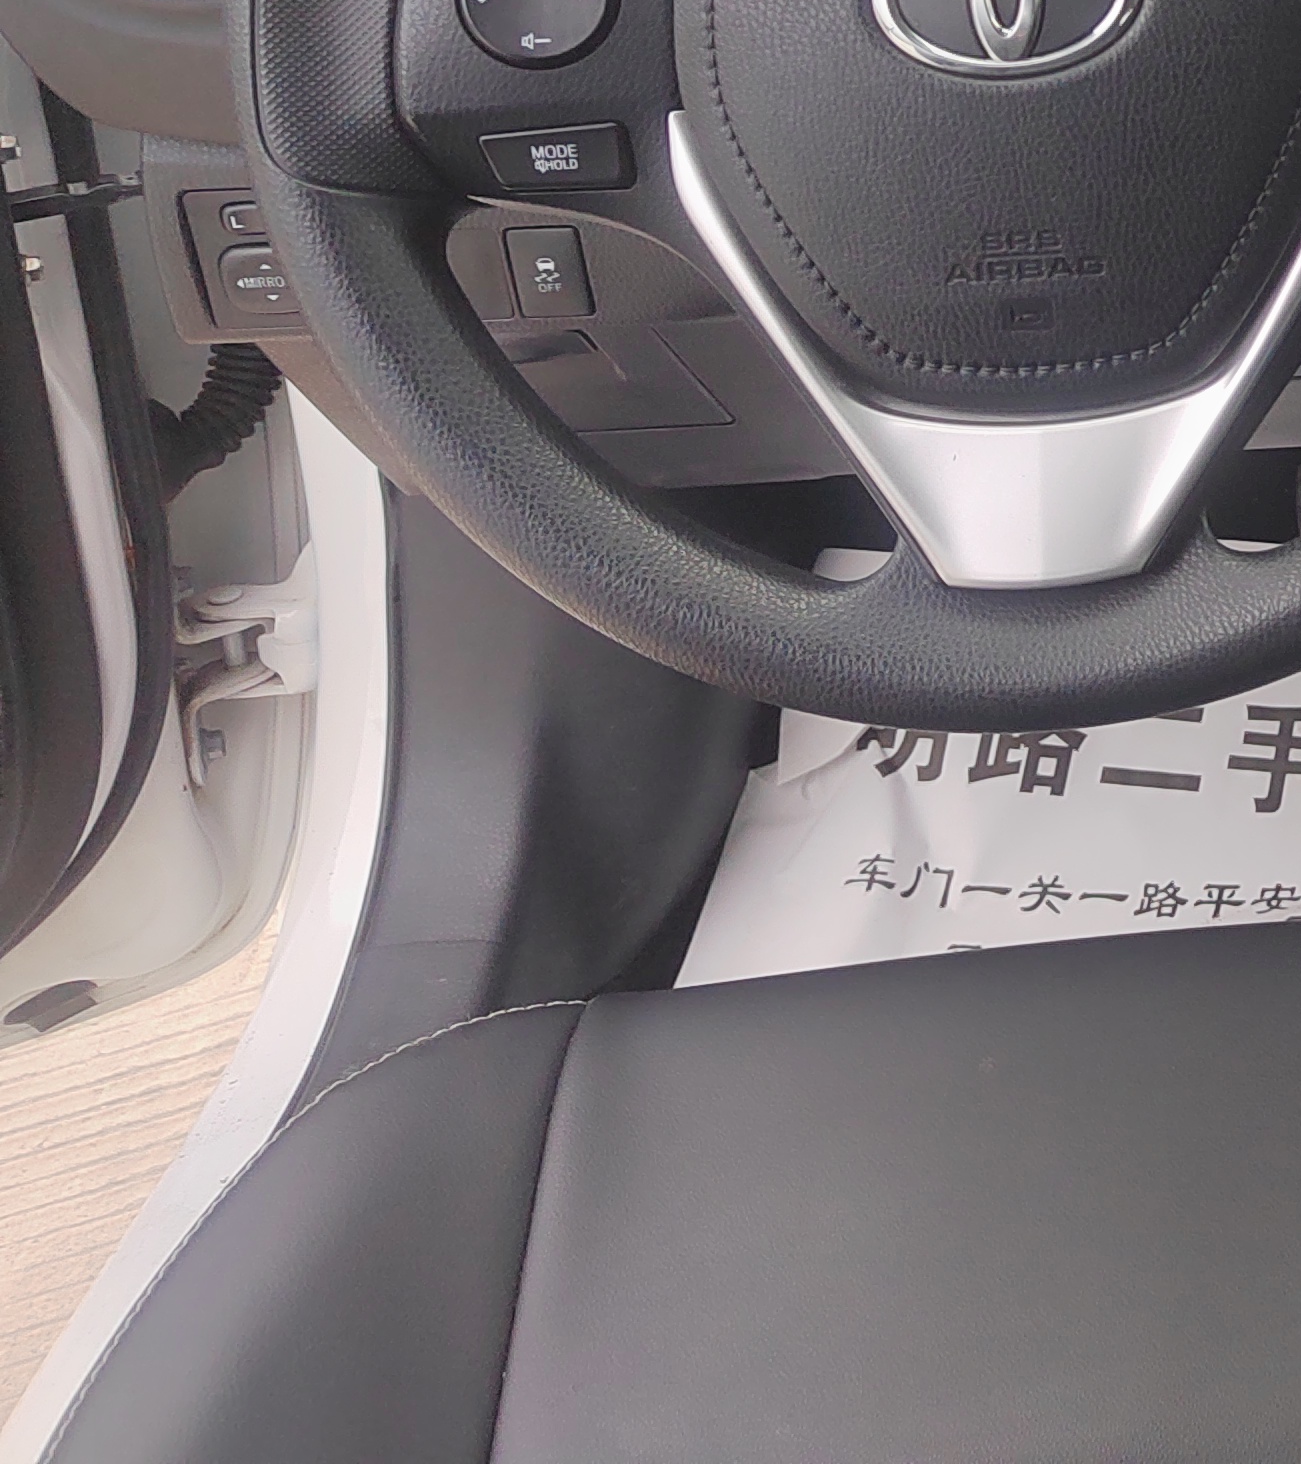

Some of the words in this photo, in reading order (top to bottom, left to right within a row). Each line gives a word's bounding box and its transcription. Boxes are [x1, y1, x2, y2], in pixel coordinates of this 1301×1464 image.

[530, 143, 579, 159] MODE
[546, 158, 579, 171] HOLD
[538, 282, 562, 293] OFF
